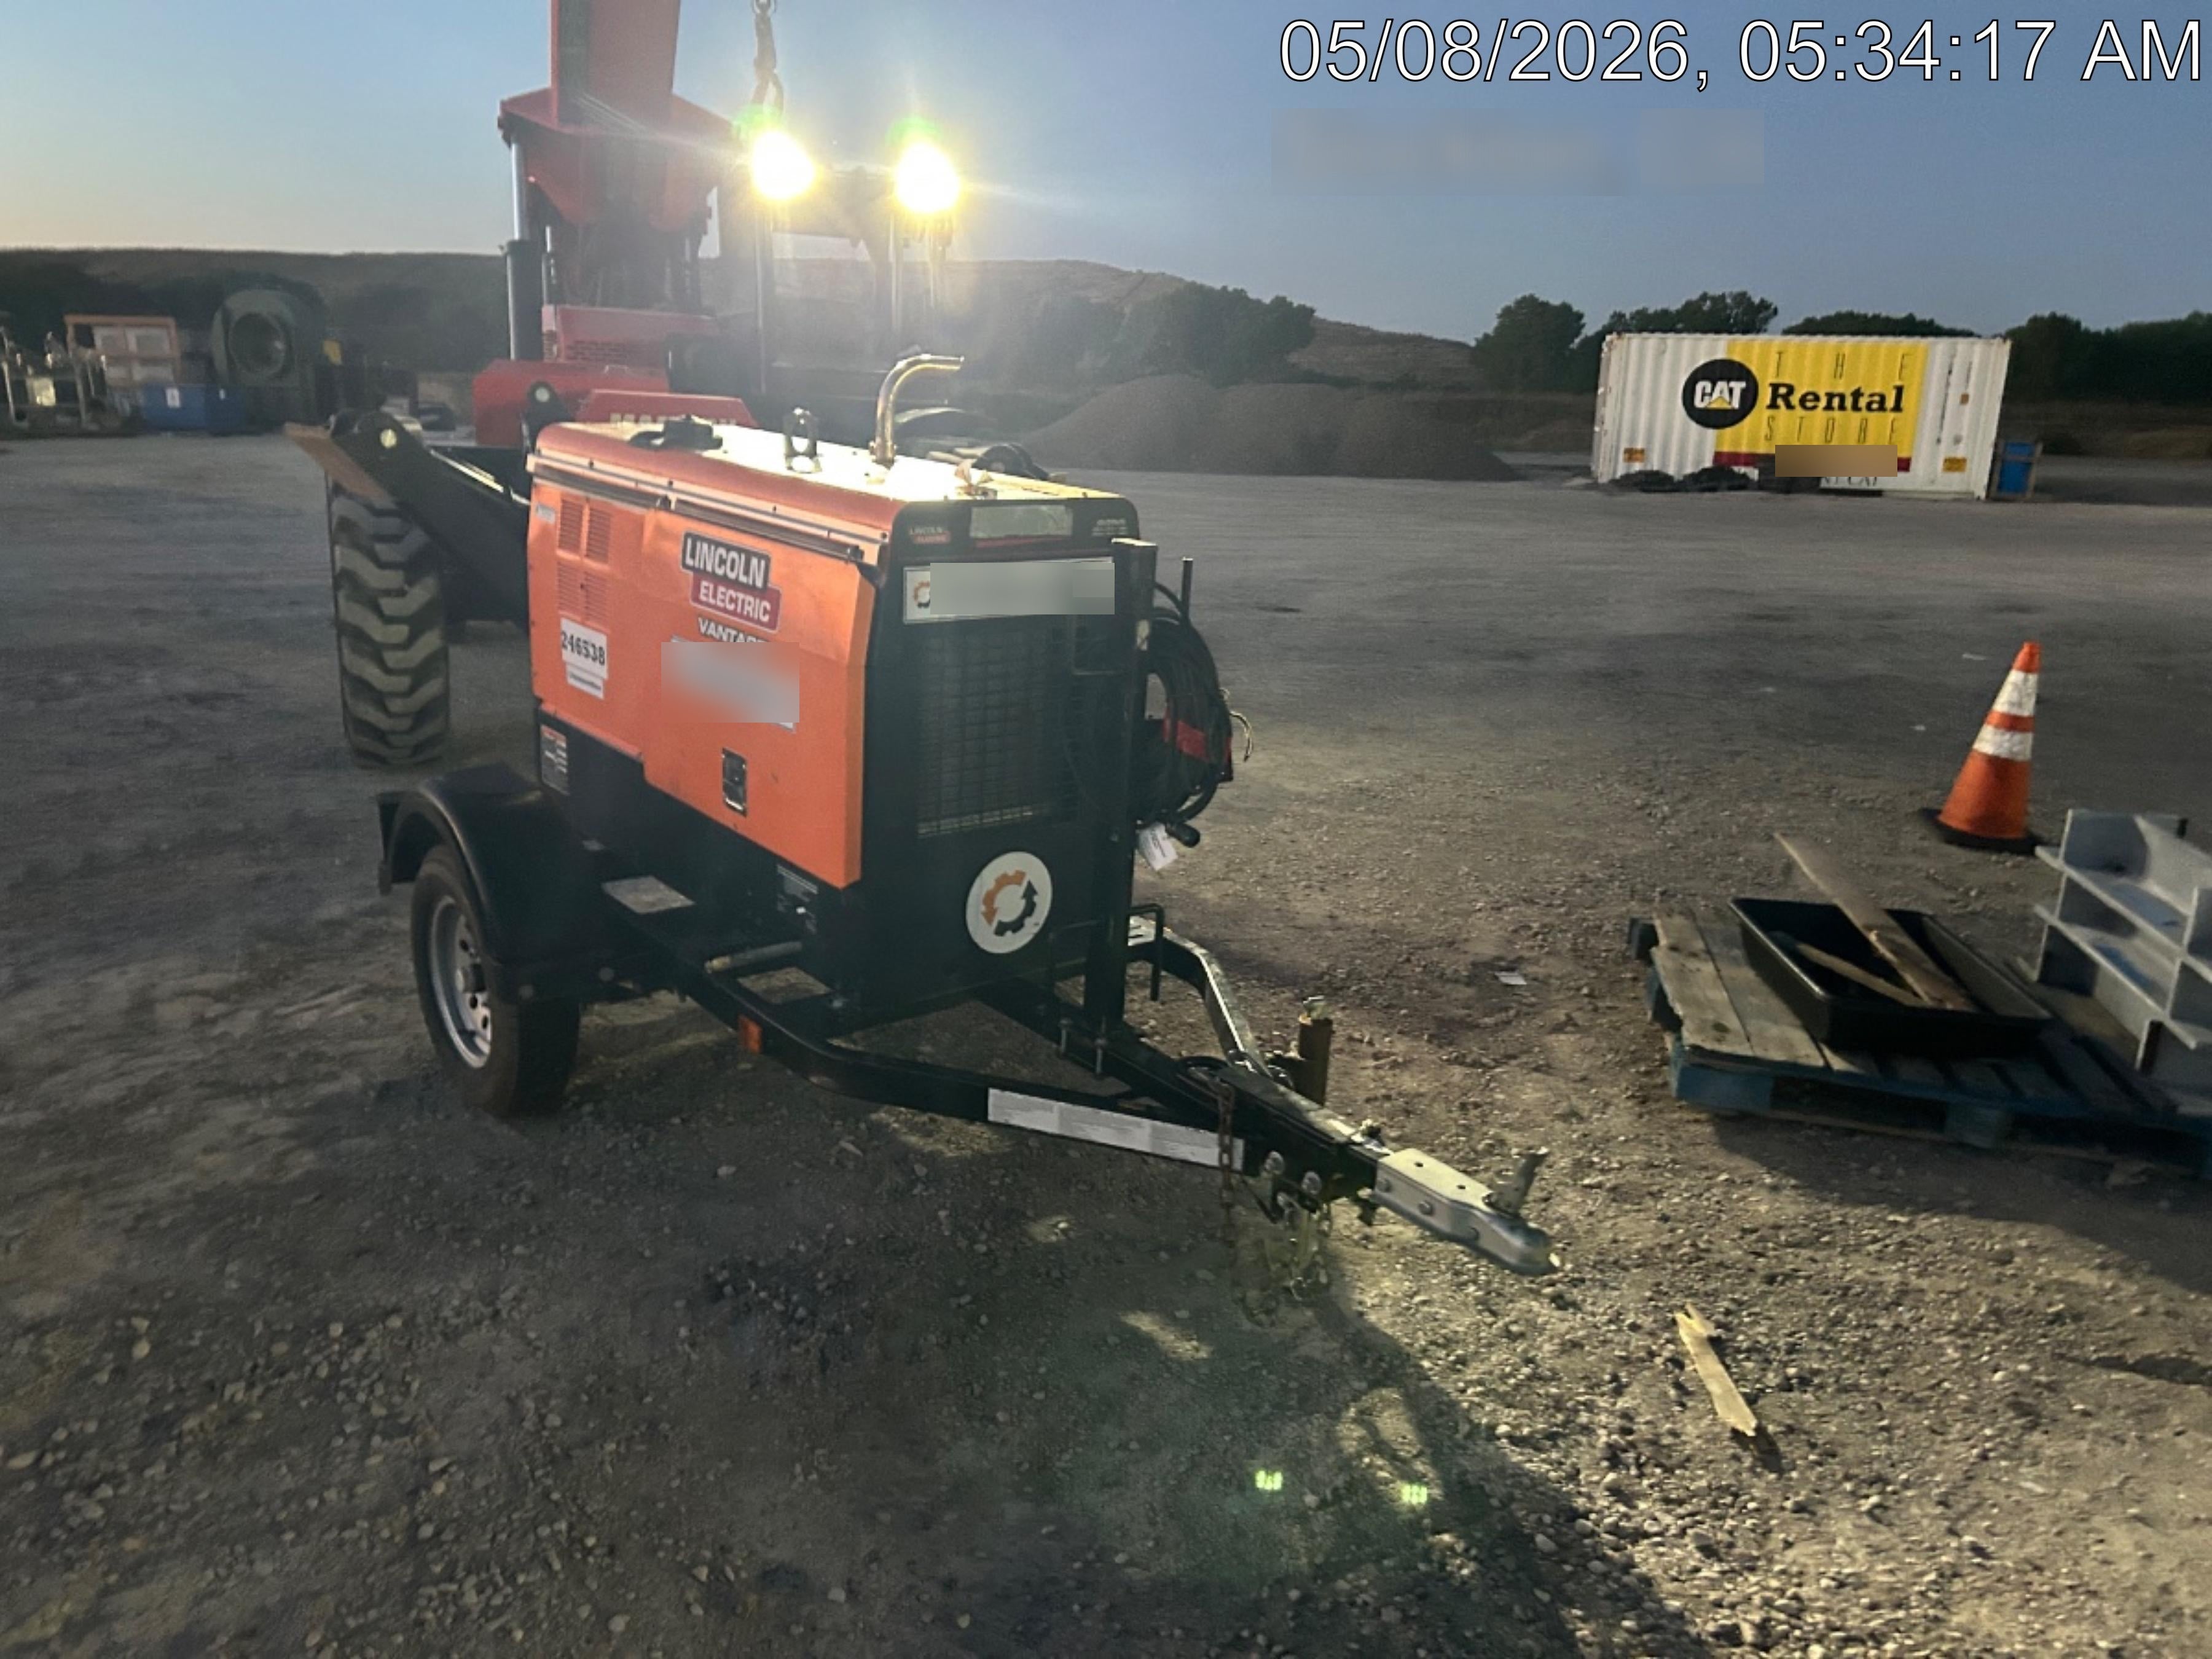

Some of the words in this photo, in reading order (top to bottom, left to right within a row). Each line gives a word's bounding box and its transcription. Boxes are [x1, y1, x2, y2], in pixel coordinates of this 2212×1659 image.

[1775, 350, 1913, 380] THE
[1694, 380, 1746, 409] CAT
[1766, 382, 1904, 412] Rental
[685, 537, 766, 588] LINCOLN
[699, 580, 771, 622] ELECTRIC
[561, 630, 605, 665] 246538
